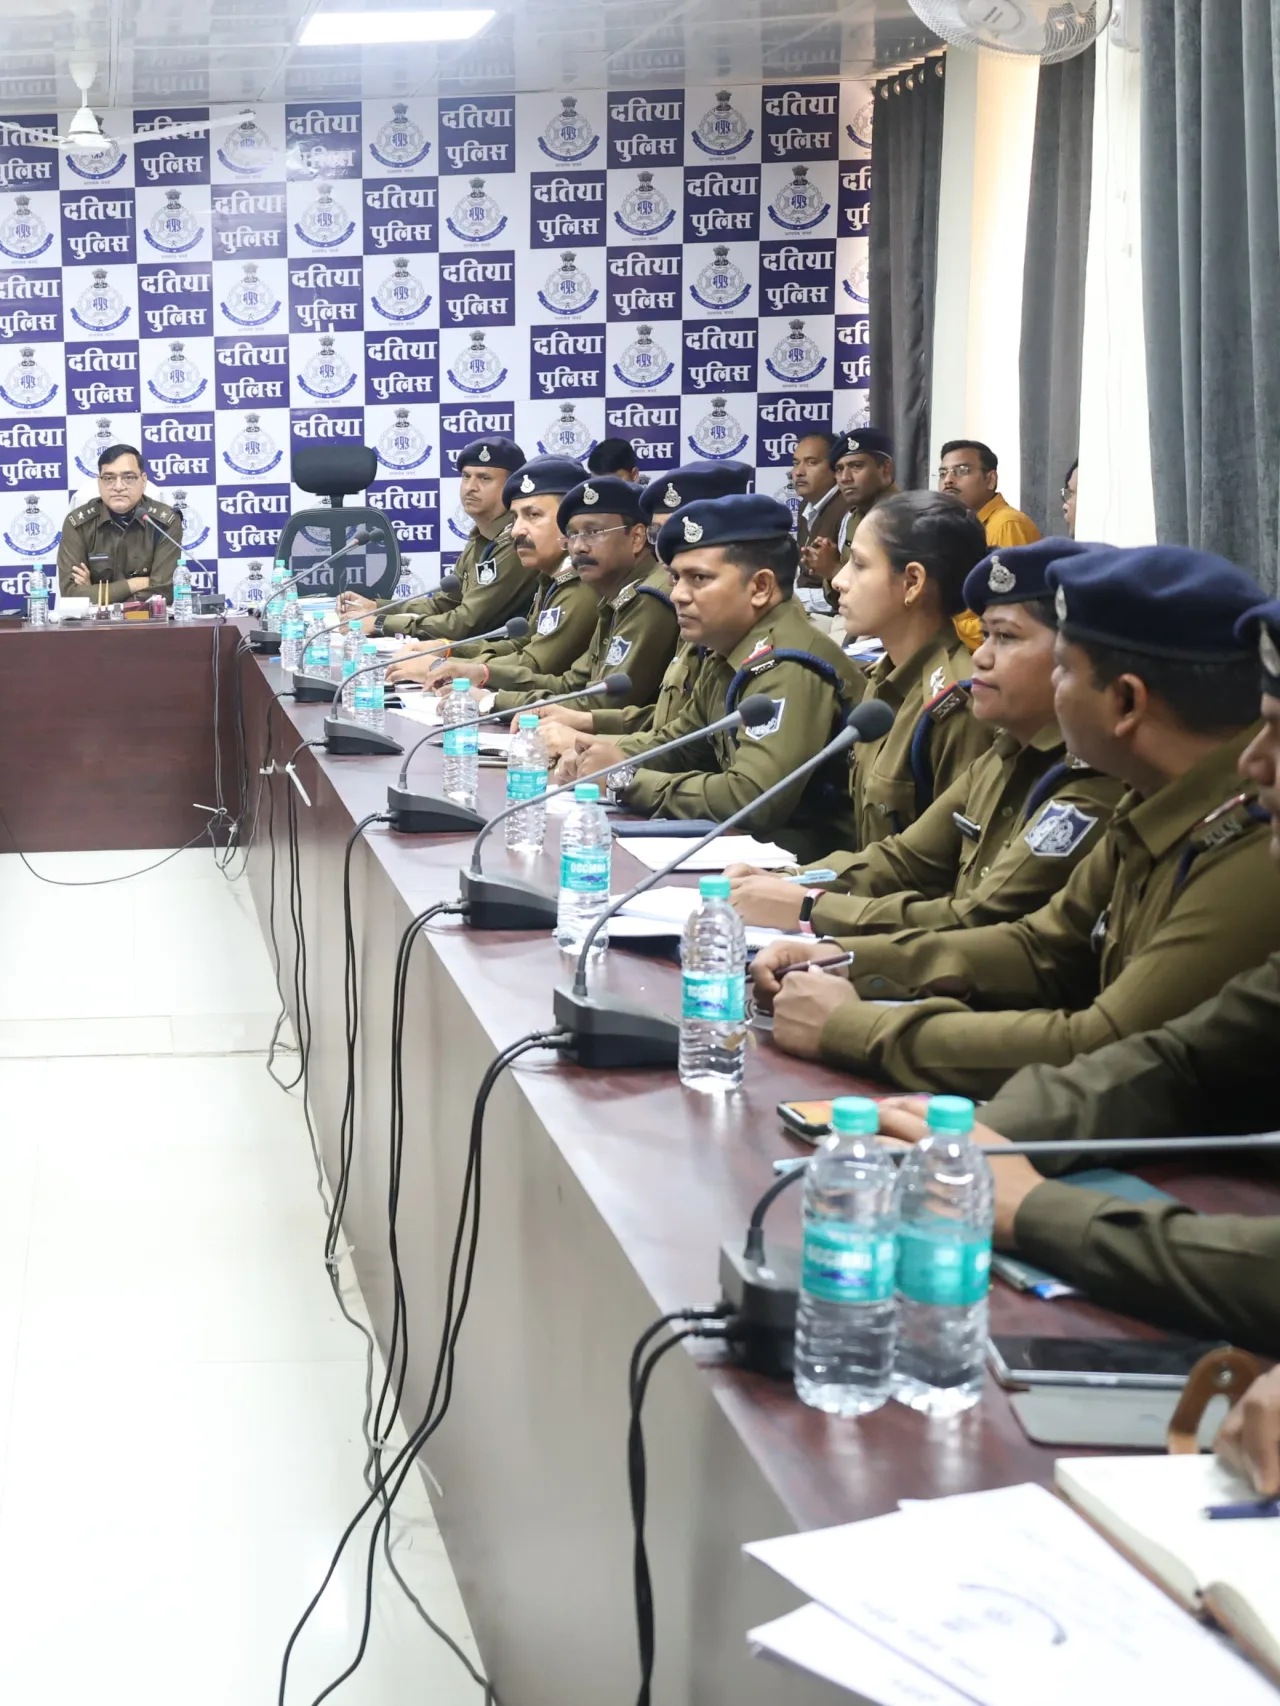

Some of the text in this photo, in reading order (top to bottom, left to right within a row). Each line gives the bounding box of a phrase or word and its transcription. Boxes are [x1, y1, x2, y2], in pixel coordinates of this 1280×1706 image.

[440, 103, 512, 129] दतिया
[609, 97, 682, 122] दतिया
[763, 91, 837, 116] दतिया
[287, 110, 359, 135] दतिया
[613, 133, 677, 162] पुलिस
[767, 127, 832, 156] पुलिस
[140, 152, 203, 181] पुलिस
[444, 140, 508, 169] पुलिस
[364, 184, 436, 209] दतिया
[532, 178, 604, 202] दतिया
[685, 172, 758, 196] दतिया
[61, 196, 133, 220] दतिया
[212, 190, 284, 215] दतिया
[369, 219, 432, 248] पुलिस
[536, 214, 600, 242] पुलिस
[689, 208, 753, 236] पुलिस
[67, 231, 130, 260] पुलिस
[217, 225, 280, 254] पुलिस
[440, 257, 513, 282] दतिया
[608, 251, 680, 276] दतिया
[761, 246, 834, 270] दतिया
[139, 269, 210, 293] दतिया
[289, 263, 361, 288] दतिया
[445, 293, 508, 321] पुलिस
[612, 287, 675, 315] पुलिस
[765, 282, 829, 310] पुलिस
[144, 304, 206, 332] पुलिस
[294, 298, 357, 327] पुलिस
[366, 336, 437, 360] दतिया
[532, 330, 604, 354] दतिया
[683, 325, 756, 349] दतिया
[66, 347, 137, 371] दतिया
[215, 341, 287, 366] दतिया
[370, 371, 433, 399] पुलिस
[536, 365, 599, 393] पुलिस
[687, 360, 751, 388] पुलिस
[71, 382, 133, 409] पुलिस
[220, 376, 283, 404] पुलिस
[441, 408, 513, 432] दतिया
[607, 403, 679, 427] दतिया
[758, 398, 831, 422] दतिया
[142, 418, 213, 443] दतिया
[291, 413, 363, 438] दतिया
[0, 458, 61, 486] पुलिस
[147, 453, 210, 481] पुलिस
[218, 490, 289, 514] दतिया
[367, 485, 438, 509] दतिया
